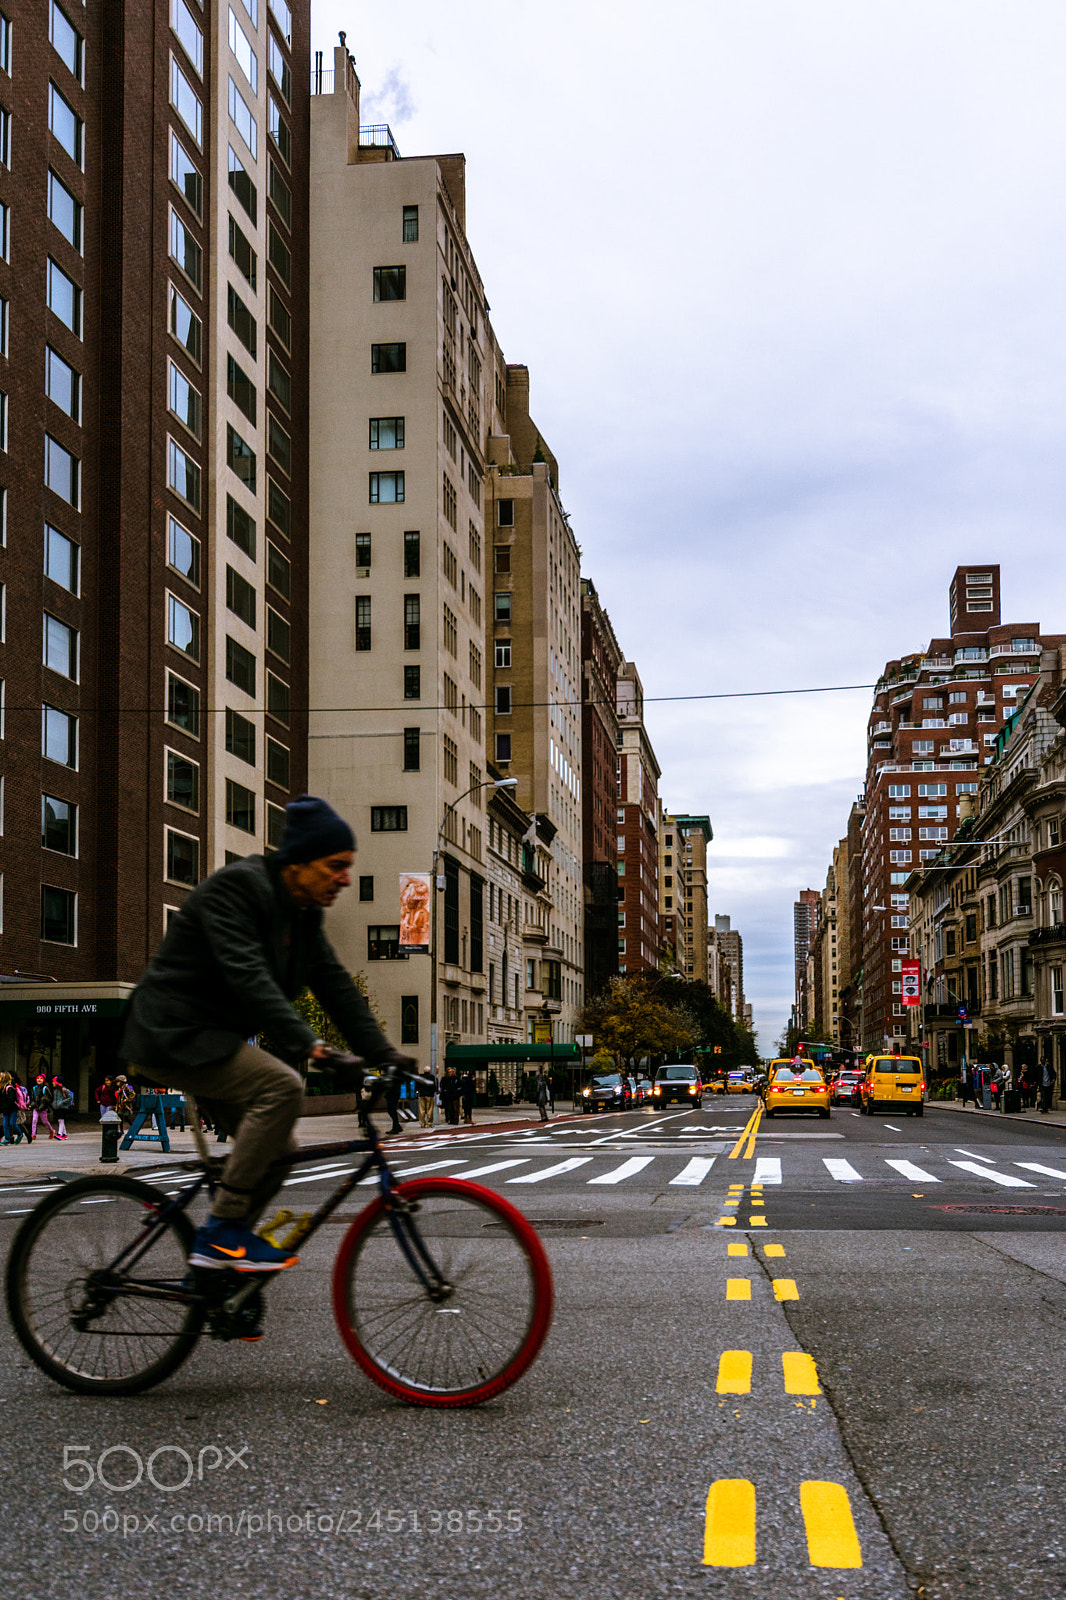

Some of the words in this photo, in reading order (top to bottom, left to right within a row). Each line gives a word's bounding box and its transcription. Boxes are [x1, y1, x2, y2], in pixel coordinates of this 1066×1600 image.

[36, 1005, 52, 1013] 980
[54, 1004, 79, 1013] FIFTH
[81, 1004, 98, 1013] AVE
